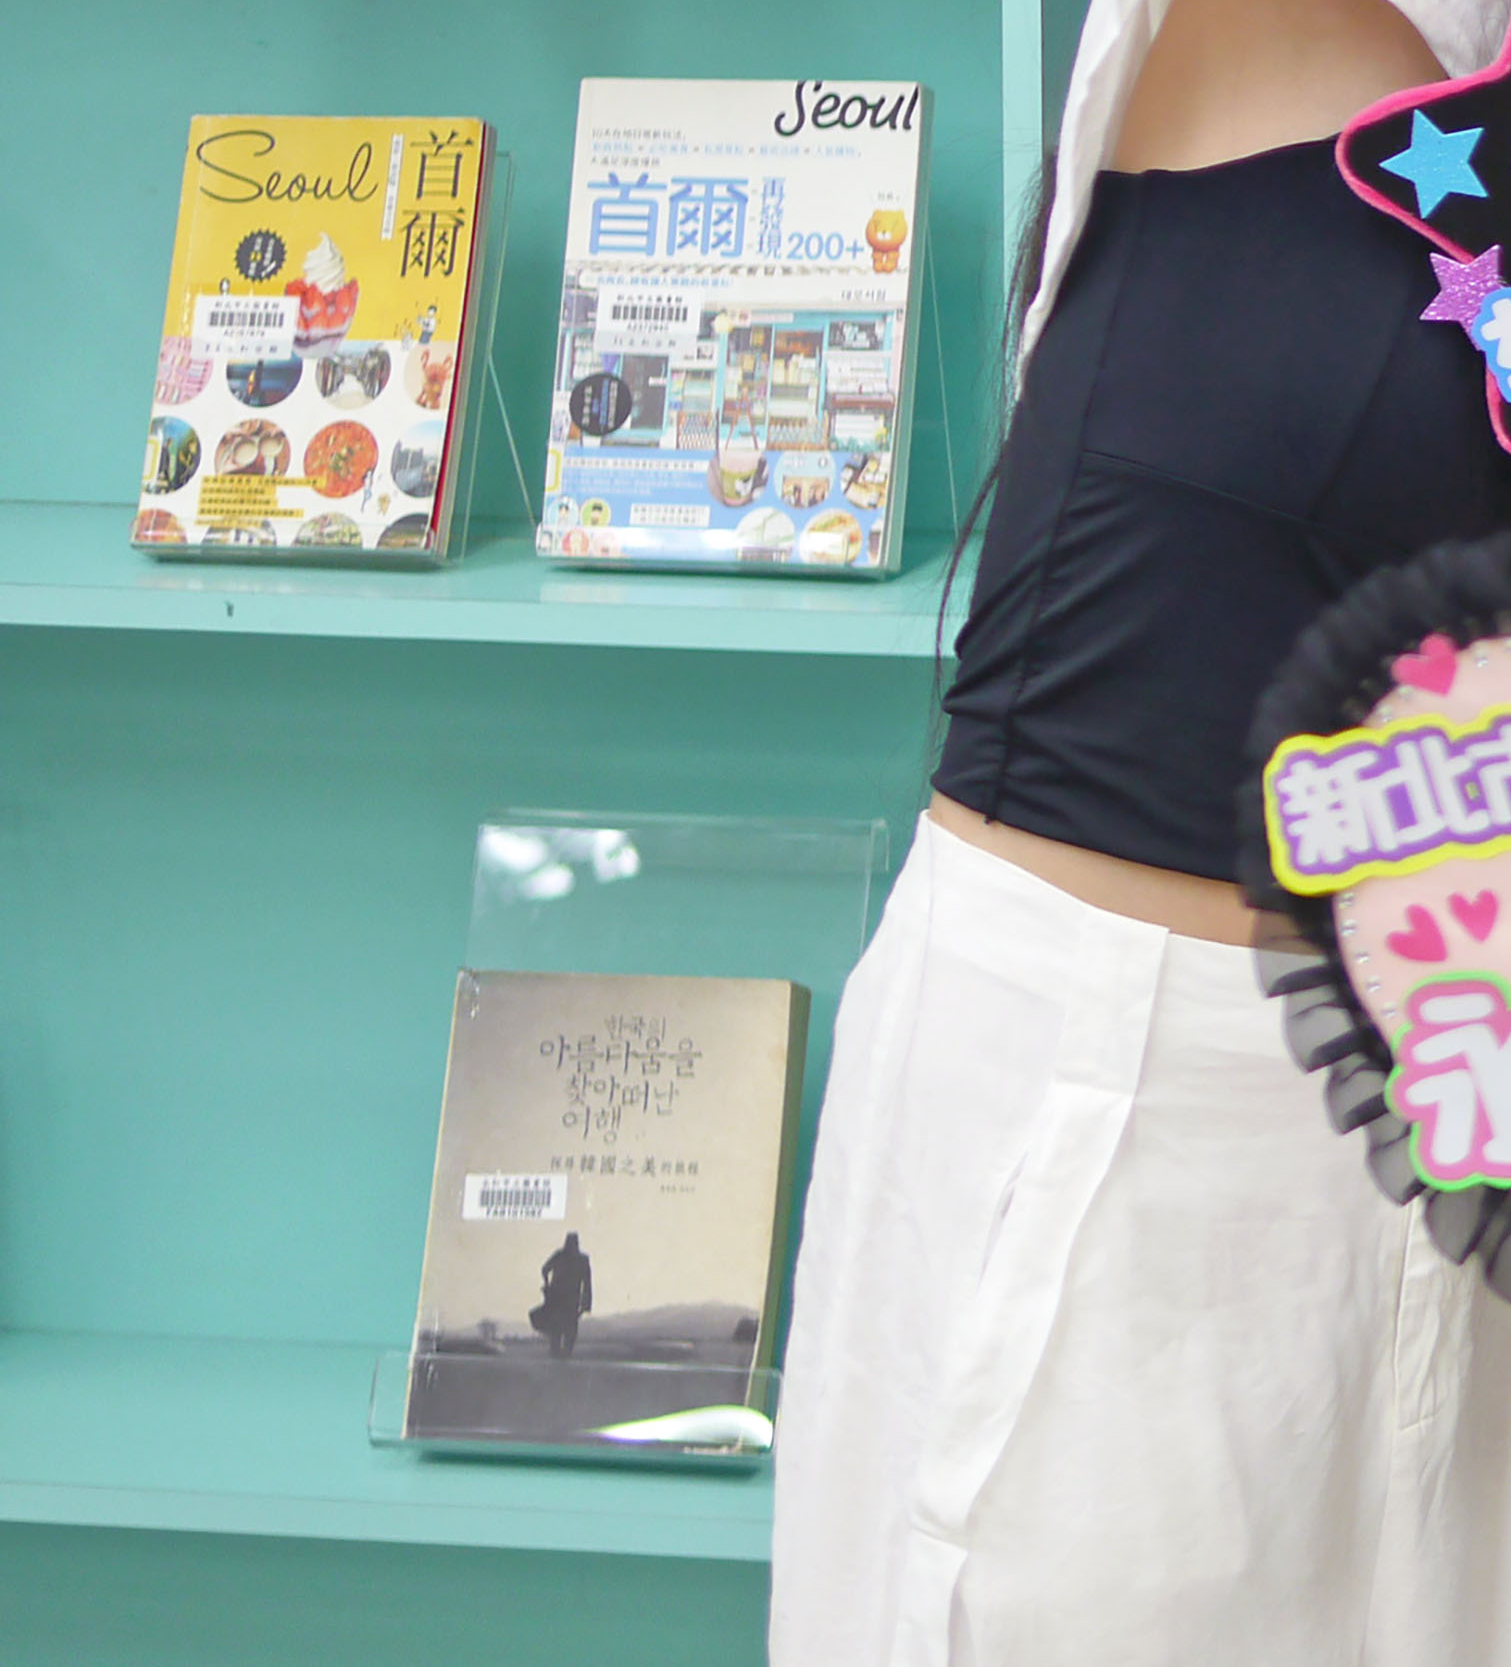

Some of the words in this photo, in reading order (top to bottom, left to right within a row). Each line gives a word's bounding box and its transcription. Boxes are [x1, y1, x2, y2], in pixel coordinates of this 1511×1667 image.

[773, 80, 919, 137] Seoul
[196, 129, 379, 203] Seoul
[400, 129, 474, 278] 首爾
[586, 170, 750, 258] 首爾
[786, 232, 865, 261] 200+
[539, 1034, 703, 1078] 아름다움을
